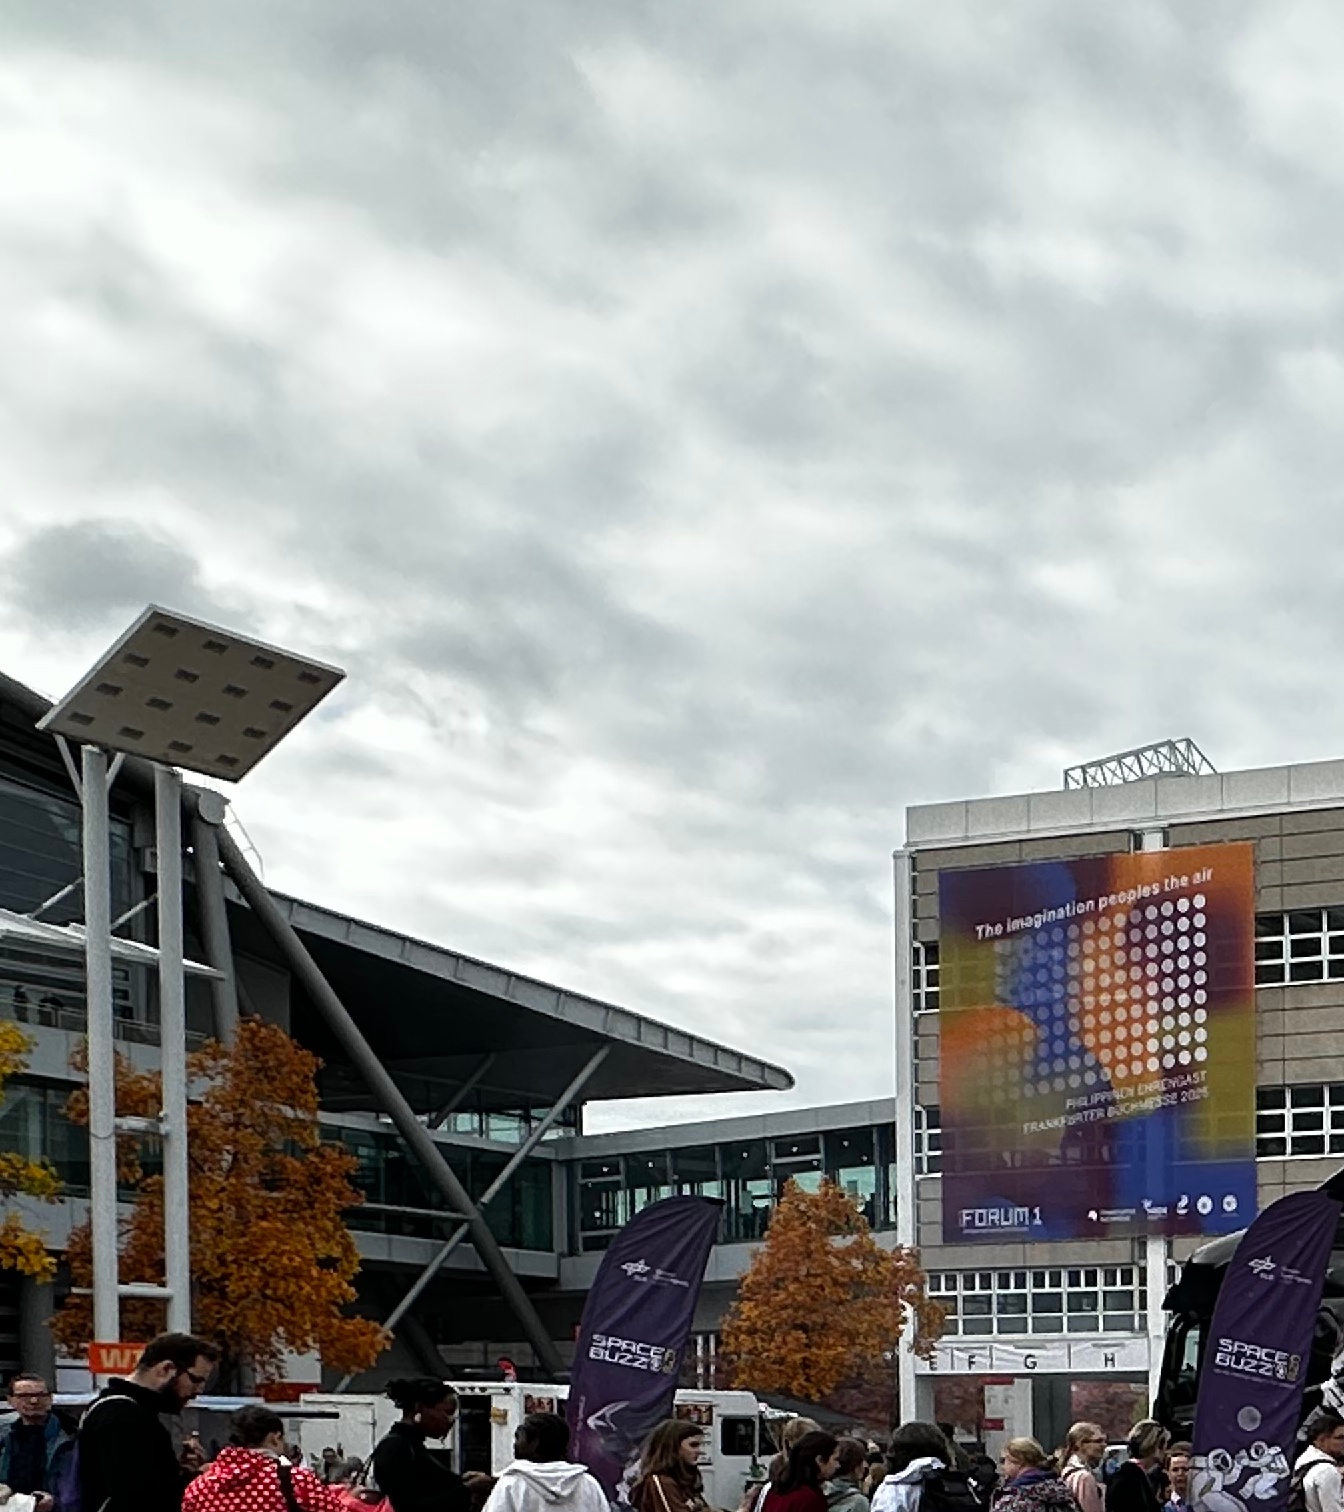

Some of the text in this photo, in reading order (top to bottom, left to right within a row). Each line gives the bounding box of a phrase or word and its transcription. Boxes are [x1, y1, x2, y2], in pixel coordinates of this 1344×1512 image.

[975, 866, 1214, 941] The imagination peoples the air
[959, 1207, 1030, 1228] FORUM
[592, 1333, 666, 1358] SPACE
[1218, 1338, 1290, 1363] SPACE
[968, 1354, 977, 1370] F
[1024, 1354, 1038, 1370] G
[1104, 1353, 1116, 1368] H
